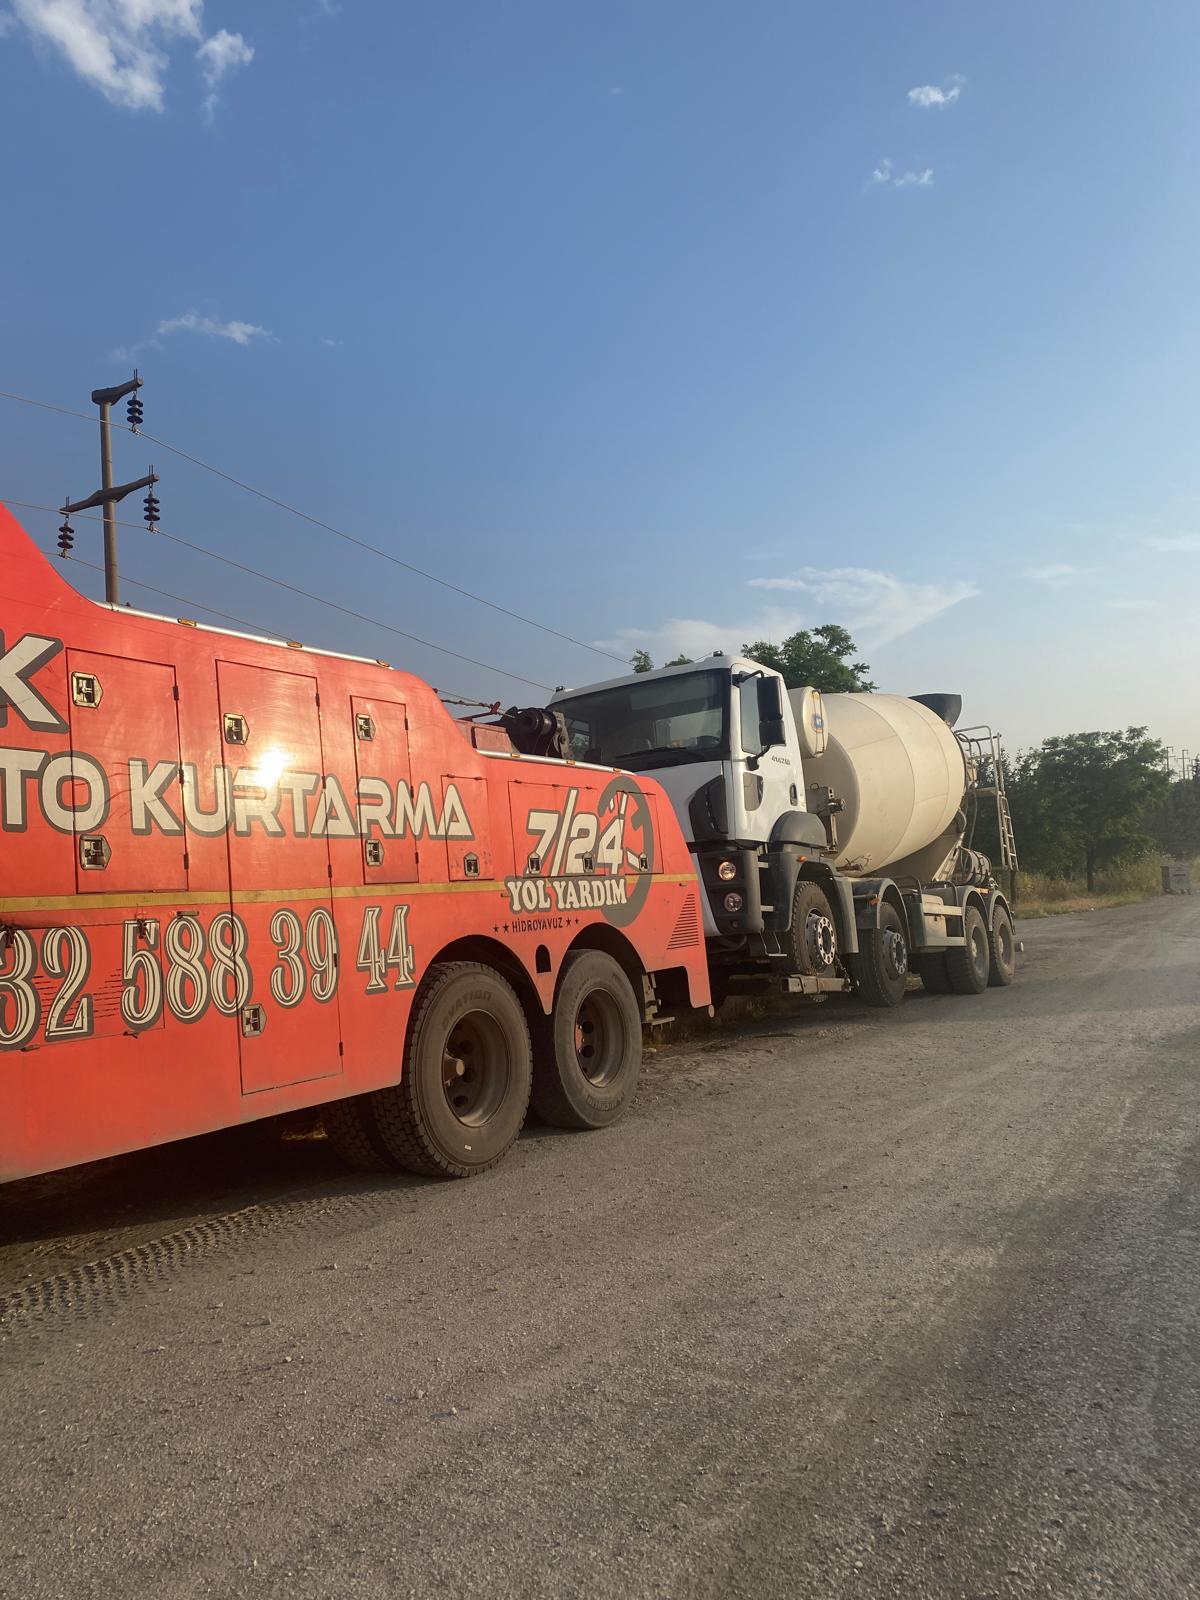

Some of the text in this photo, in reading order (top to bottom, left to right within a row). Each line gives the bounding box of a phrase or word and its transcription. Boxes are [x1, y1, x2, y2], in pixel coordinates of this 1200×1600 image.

[128, 757, 475, 838] KURTARMA
[525, 787, 629, 877] 7/24
[507, 878, 627, 911] YOL YARDIM
[512, 917, 563, 933] HİDROYAVUZ
[121, 912, 253, 1029] 588
[270, 907, 338, 1007] 39
[357, 905, 415, 994] 44
